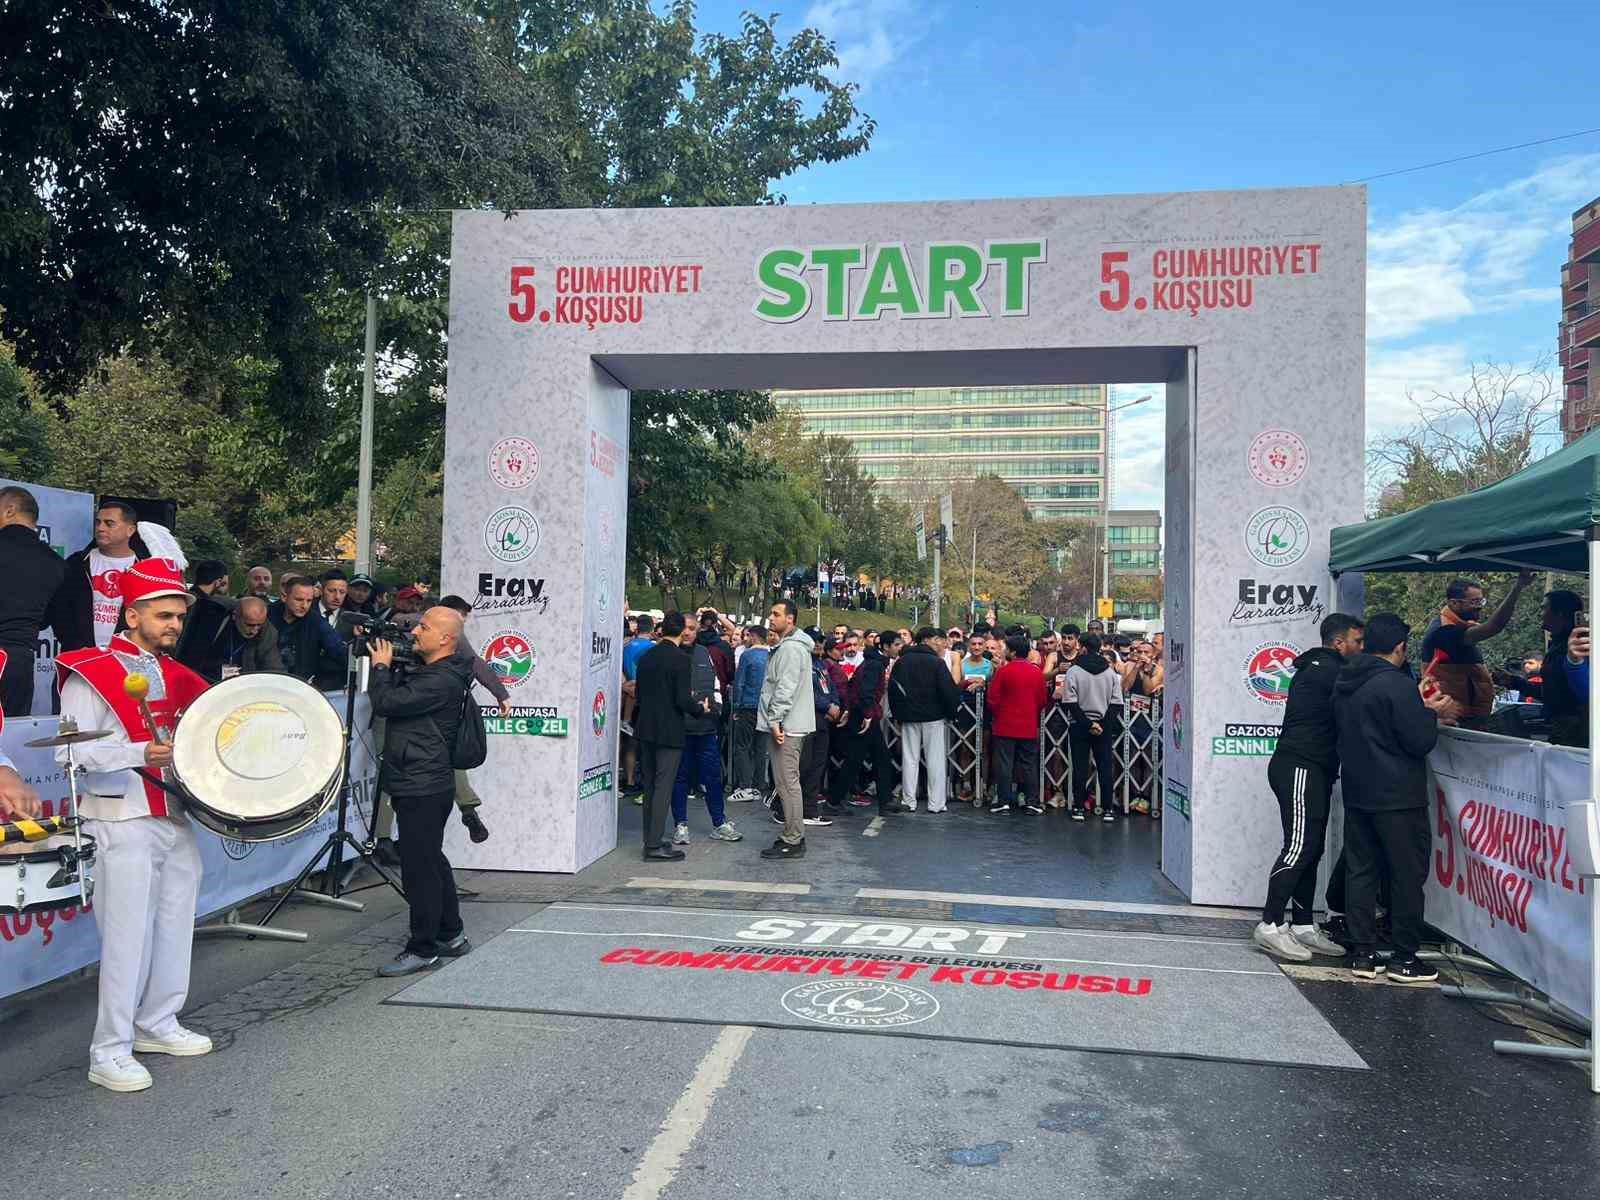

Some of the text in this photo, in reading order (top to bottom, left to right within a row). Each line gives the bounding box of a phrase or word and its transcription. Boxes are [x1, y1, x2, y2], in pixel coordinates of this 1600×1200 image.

[508, 266, 551, 323] 5.
[753, 240, 1046, 323] START
[1100, 251, 1147, 311] 5.
[1153, 279, 1252, 317] KOŞUSU
[556, 296, 643, 330] KOŞUSU
[479, 573, 544, 599] Eray
[1239, 579, 1317, 606] Eray
[485, 720, 512, 734] NLE
[1226, 725, 1283, 737] GAZİOSM
[1214, 738, 1278, 755] SENİNL
[1436, 784, 1465, 896] 5.
[735, 919, 1026, 954] START
